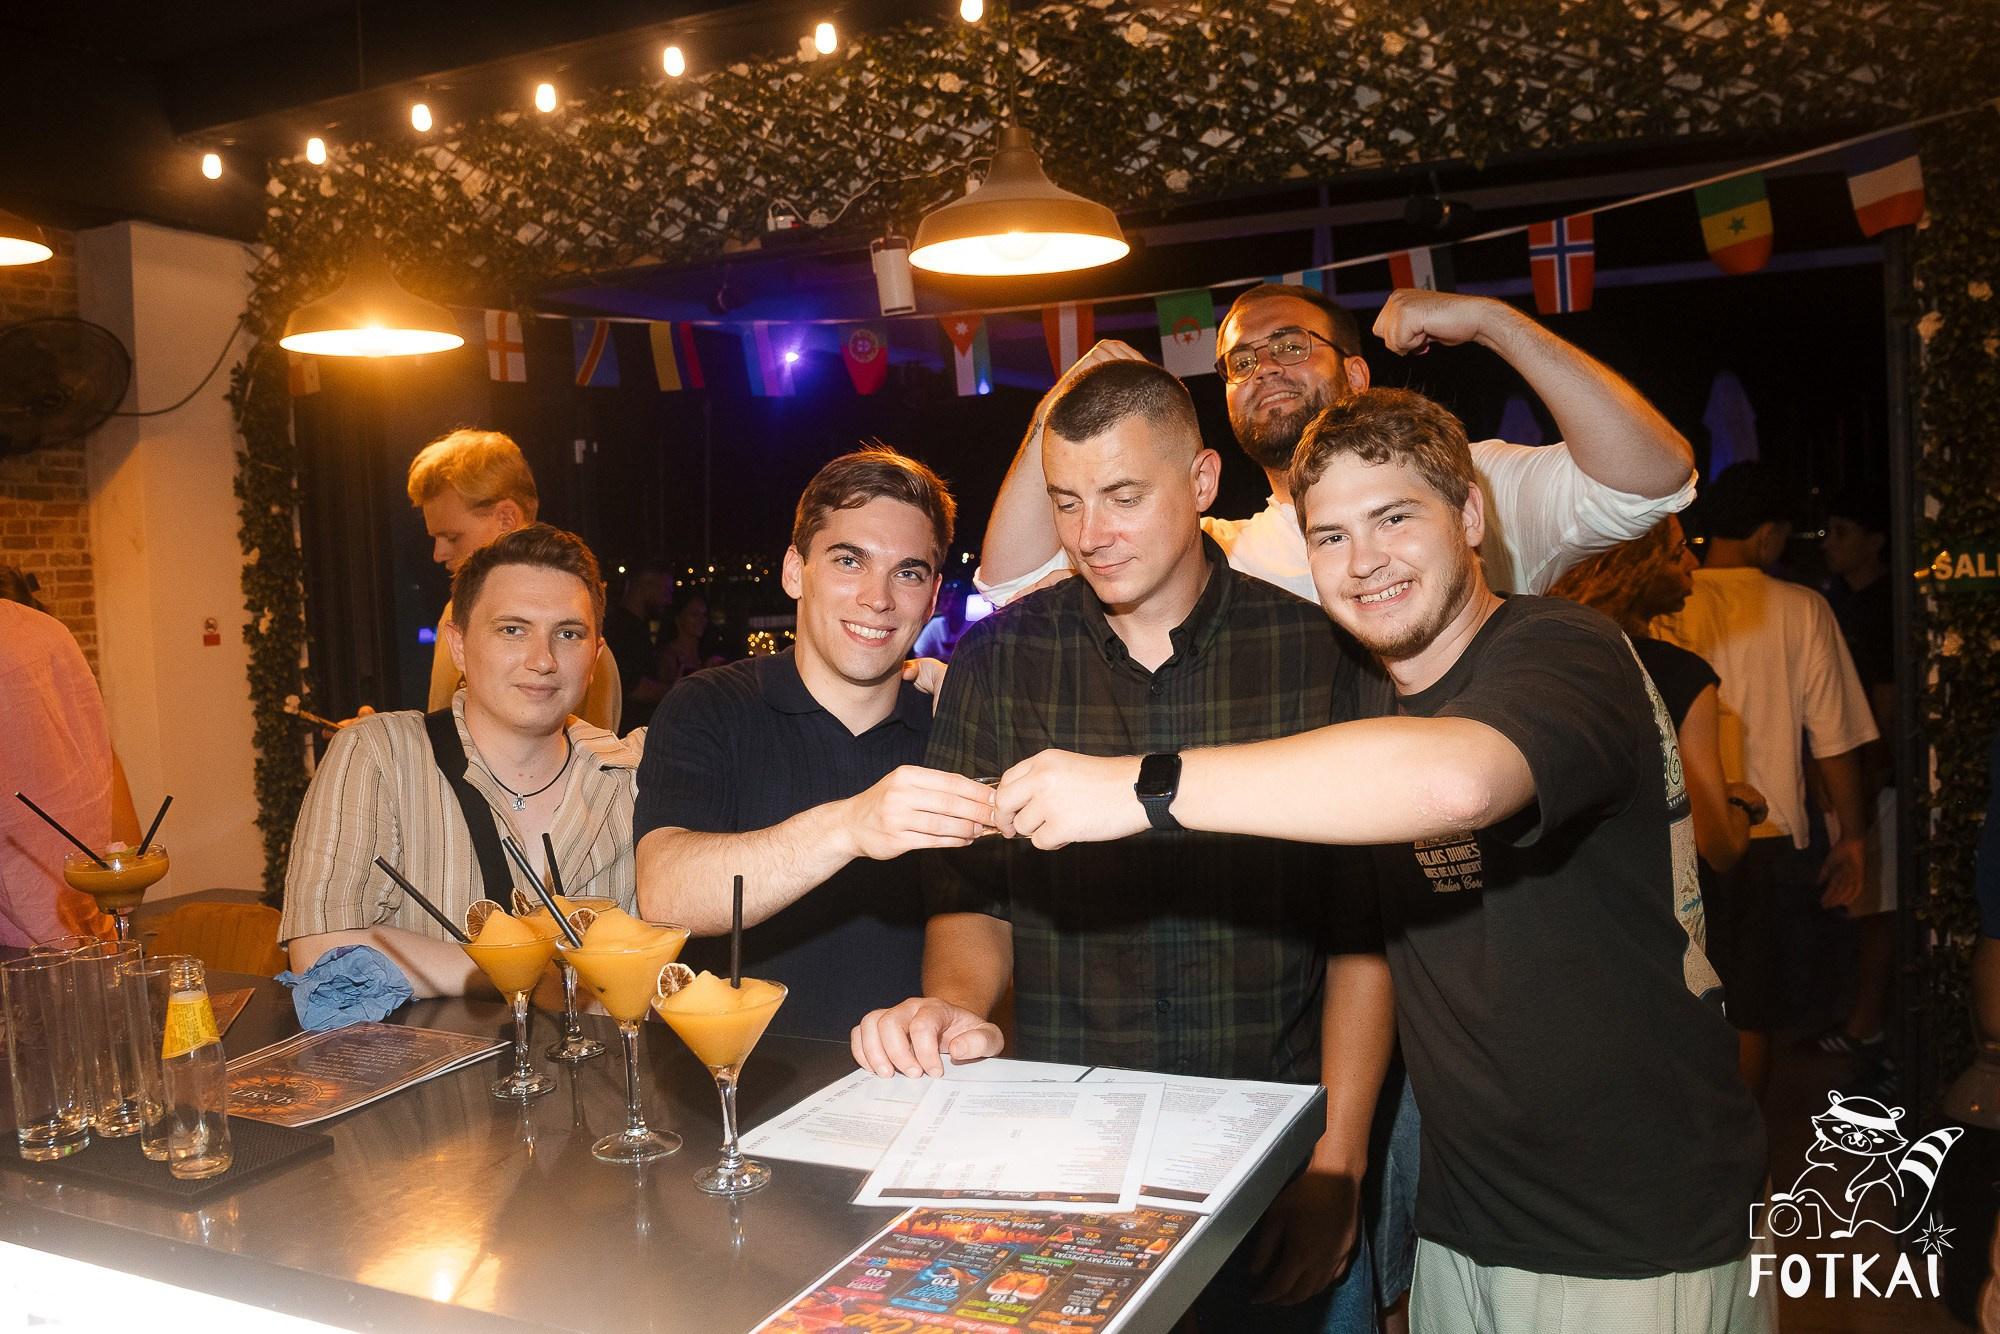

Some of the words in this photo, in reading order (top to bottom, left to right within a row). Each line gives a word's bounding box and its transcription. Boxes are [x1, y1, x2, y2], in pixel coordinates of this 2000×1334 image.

[1119, 1236, 1149, 1245] €3.50
[1053, 1251, 1086, 1260] SPECIAL
[1102, 1258, 1134, 1266] MATCH
[864, 1268, 892, 1278] €10
[930, 1277, 960, 1287] €10
[989, 1294, 1018, 1304] €10
[1061, 1305, 1091, 1315] €10
